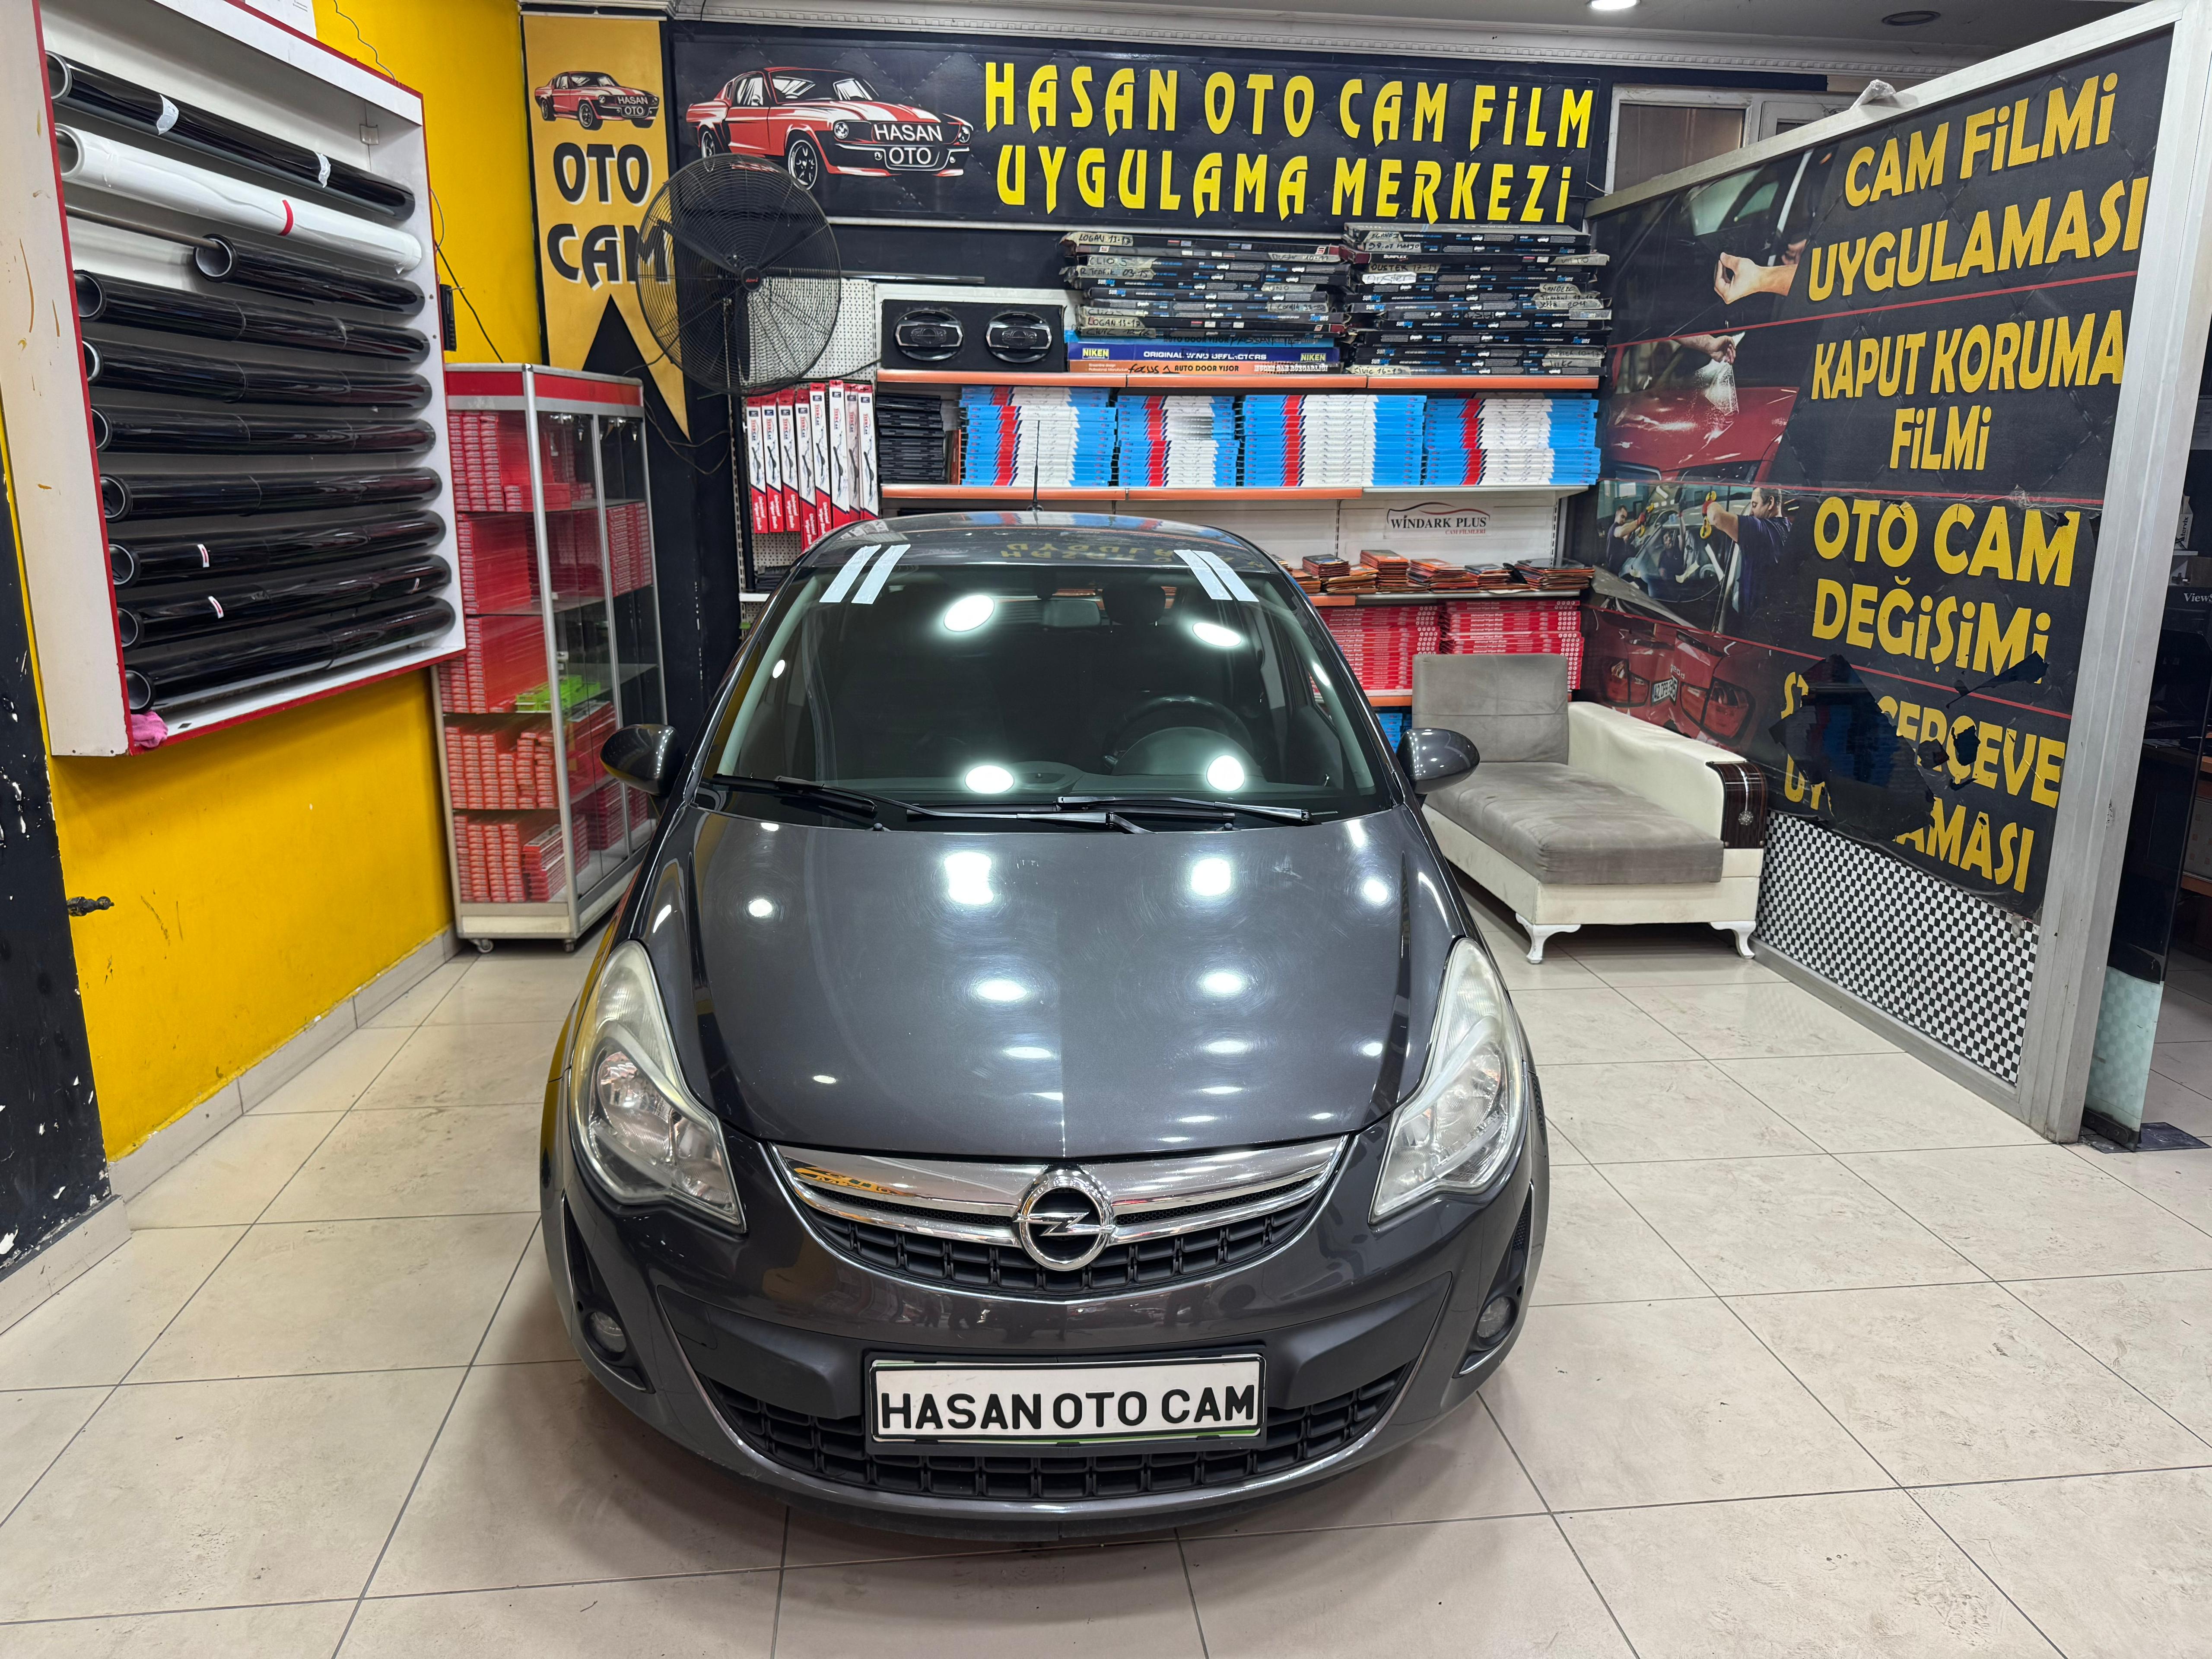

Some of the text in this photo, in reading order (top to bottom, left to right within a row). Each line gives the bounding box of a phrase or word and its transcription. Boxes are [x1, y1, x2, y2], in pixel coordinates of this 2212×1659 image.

[617, 95, 648, 105] HASAN
[986, 63, 1178, 136] HASAN
[1205, 72, 1315, 138] OTO
[1340, 79, 1448, 147] CAM
[624, 106, 644, 116] OTO
[874, 123, 943, 142] HASAN
[889, 147, 931, 164] OTO
[1846, 123, 1949, 207] CAM
[553, 143, 651, 206] OTO
[997, 144, 1309, 220] UYGULAMA
[1808, 176, 2149, 302] UYGULAMASI
[547, 223, 672, 291] CAM
[1363, 294, 1382, 302] sunplex
[1087, 316, 1116, 326] LOGAN
[1083, 349, 1109, 357] NIKEN
[1301, 353, 1326, 362] NIKEN
[1376, 348, 1396, 356] sunplex
[1812, 310, 2125, 400] KAPUT KORUMA
[1456, 517, 1487, 528] PLUS
[1814, 496, 2081, 588] OTO CAM
[881, 1385, 1255, 1430] HASAN OTO CAM
